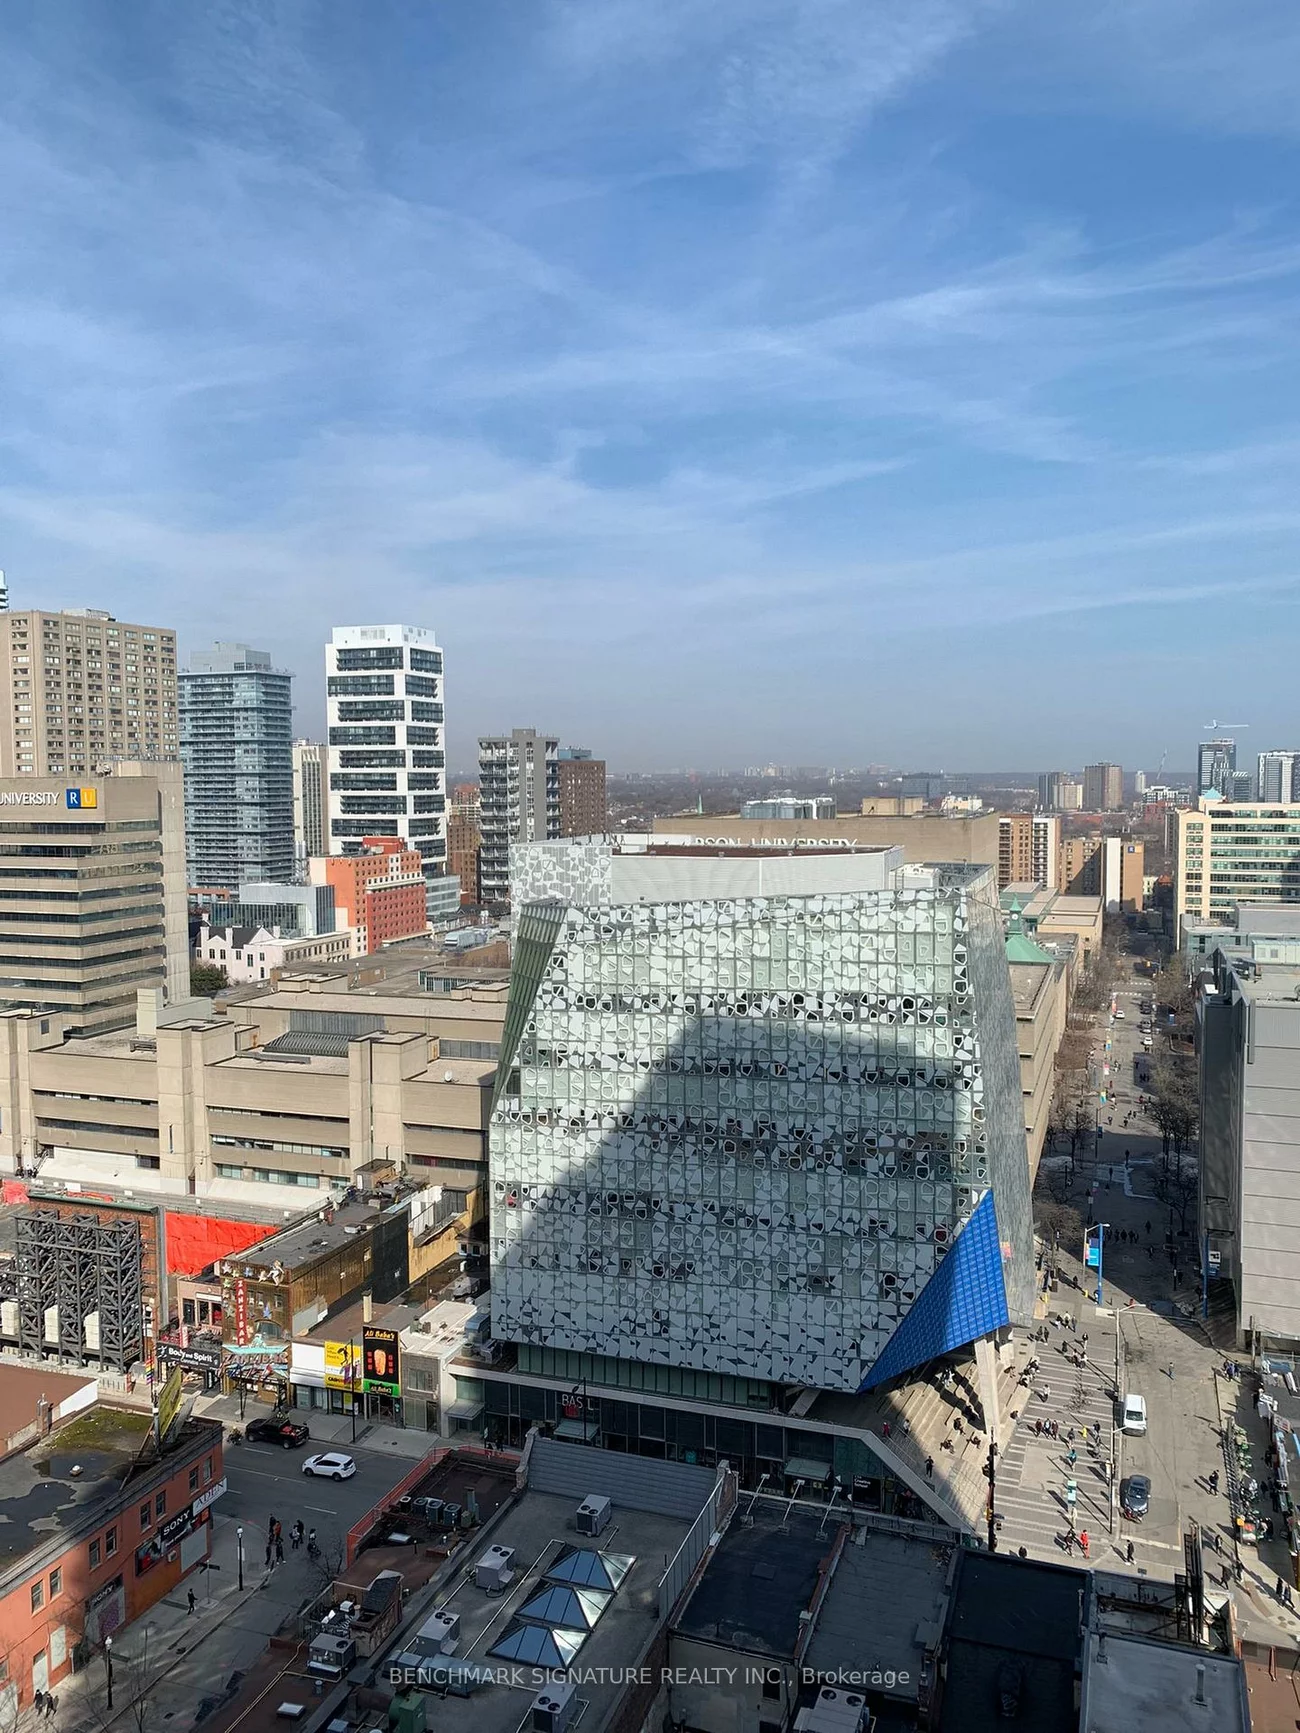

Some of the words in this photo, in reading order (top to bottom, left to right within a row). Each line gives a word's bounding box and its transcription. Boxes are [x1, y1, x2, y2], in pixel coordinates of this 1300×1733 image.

[237, 1280, 246, 1346] ZANZIBAR
[168, 1347, 186, 1361] Body
[193, 1353, 213, 1363] Spirit
[561, 1394, 595, 1411] BASL
[163, 1510, 190, 1536] SONY
